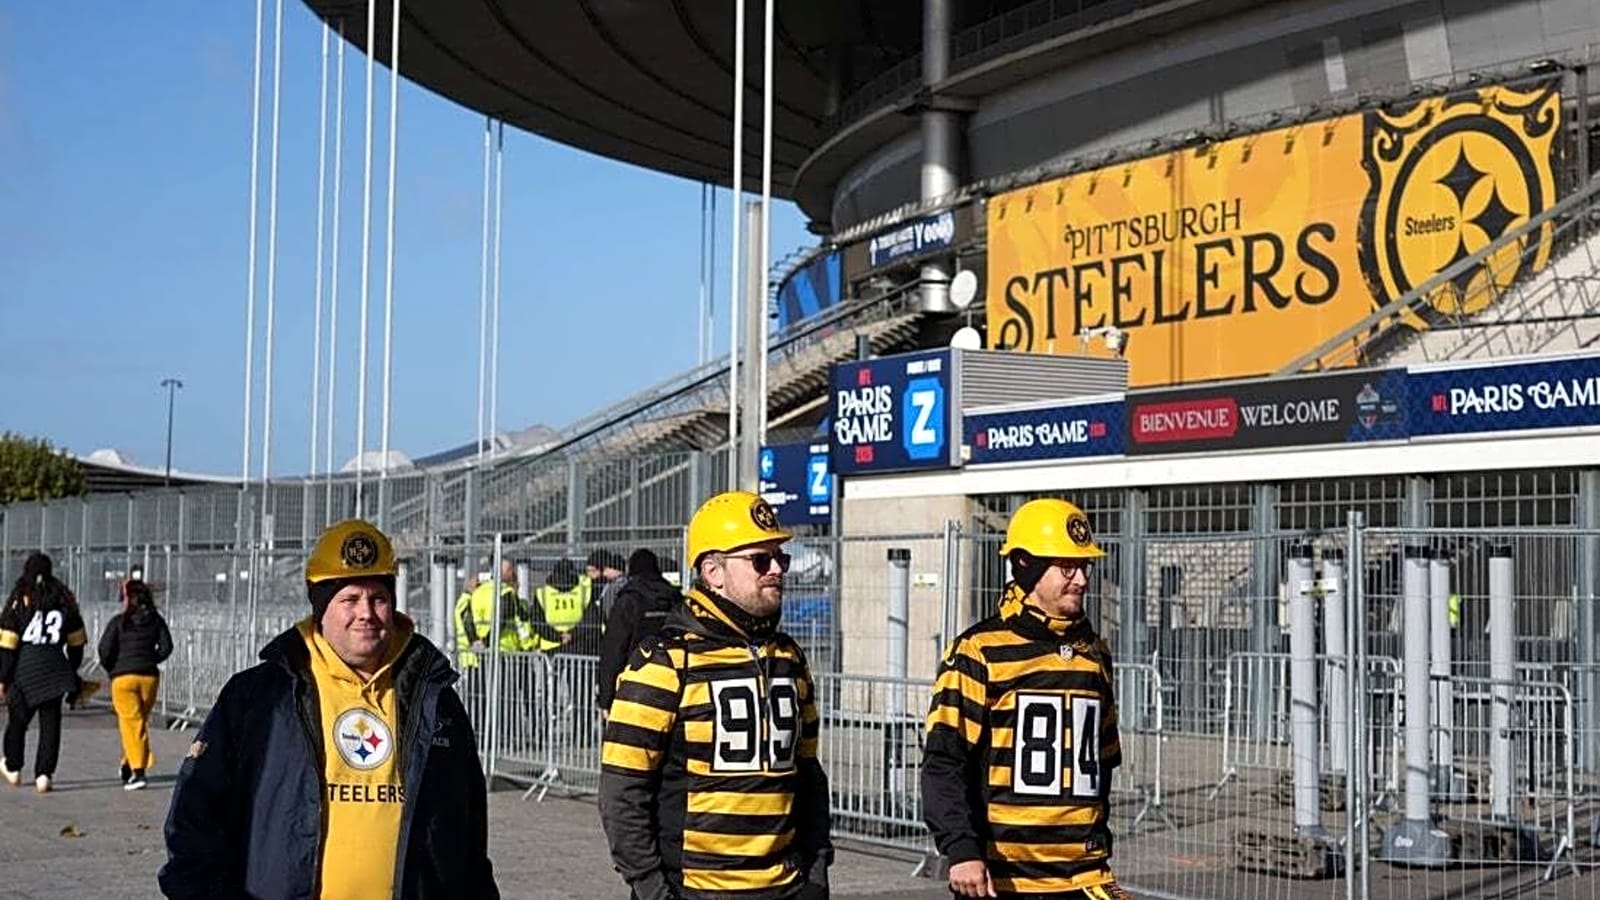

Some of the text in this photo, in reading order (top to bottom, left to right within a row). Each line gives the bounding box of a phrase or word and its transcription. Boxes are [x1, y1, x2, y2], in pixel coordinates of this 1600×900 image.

[1065, 198, 1241, 259] PITTSBURGH
[1405, 213, 1455, 236] Steelers
[999, 222, 1339, 352] STEELERS
[838, 385, 892, 418] PARIS
[1450, 383, 1524, 415] PARIS
[834, 413, 893, 445] GAME
[911, 390, 936, 445] Z
[1140, 399, 1340, 433] BIENVENUE WELCOME
[987, 424, 1034, 449] PARIS
[1036, 420, 1088, 445] GAME
[812, 463, 827, 495] Z
[22, 610, 62, 645] 43
[718, 685, 797, 763] 99
[1020, 702, 1099, 791] 84
[327, 783, 407, 803] TEELERS
